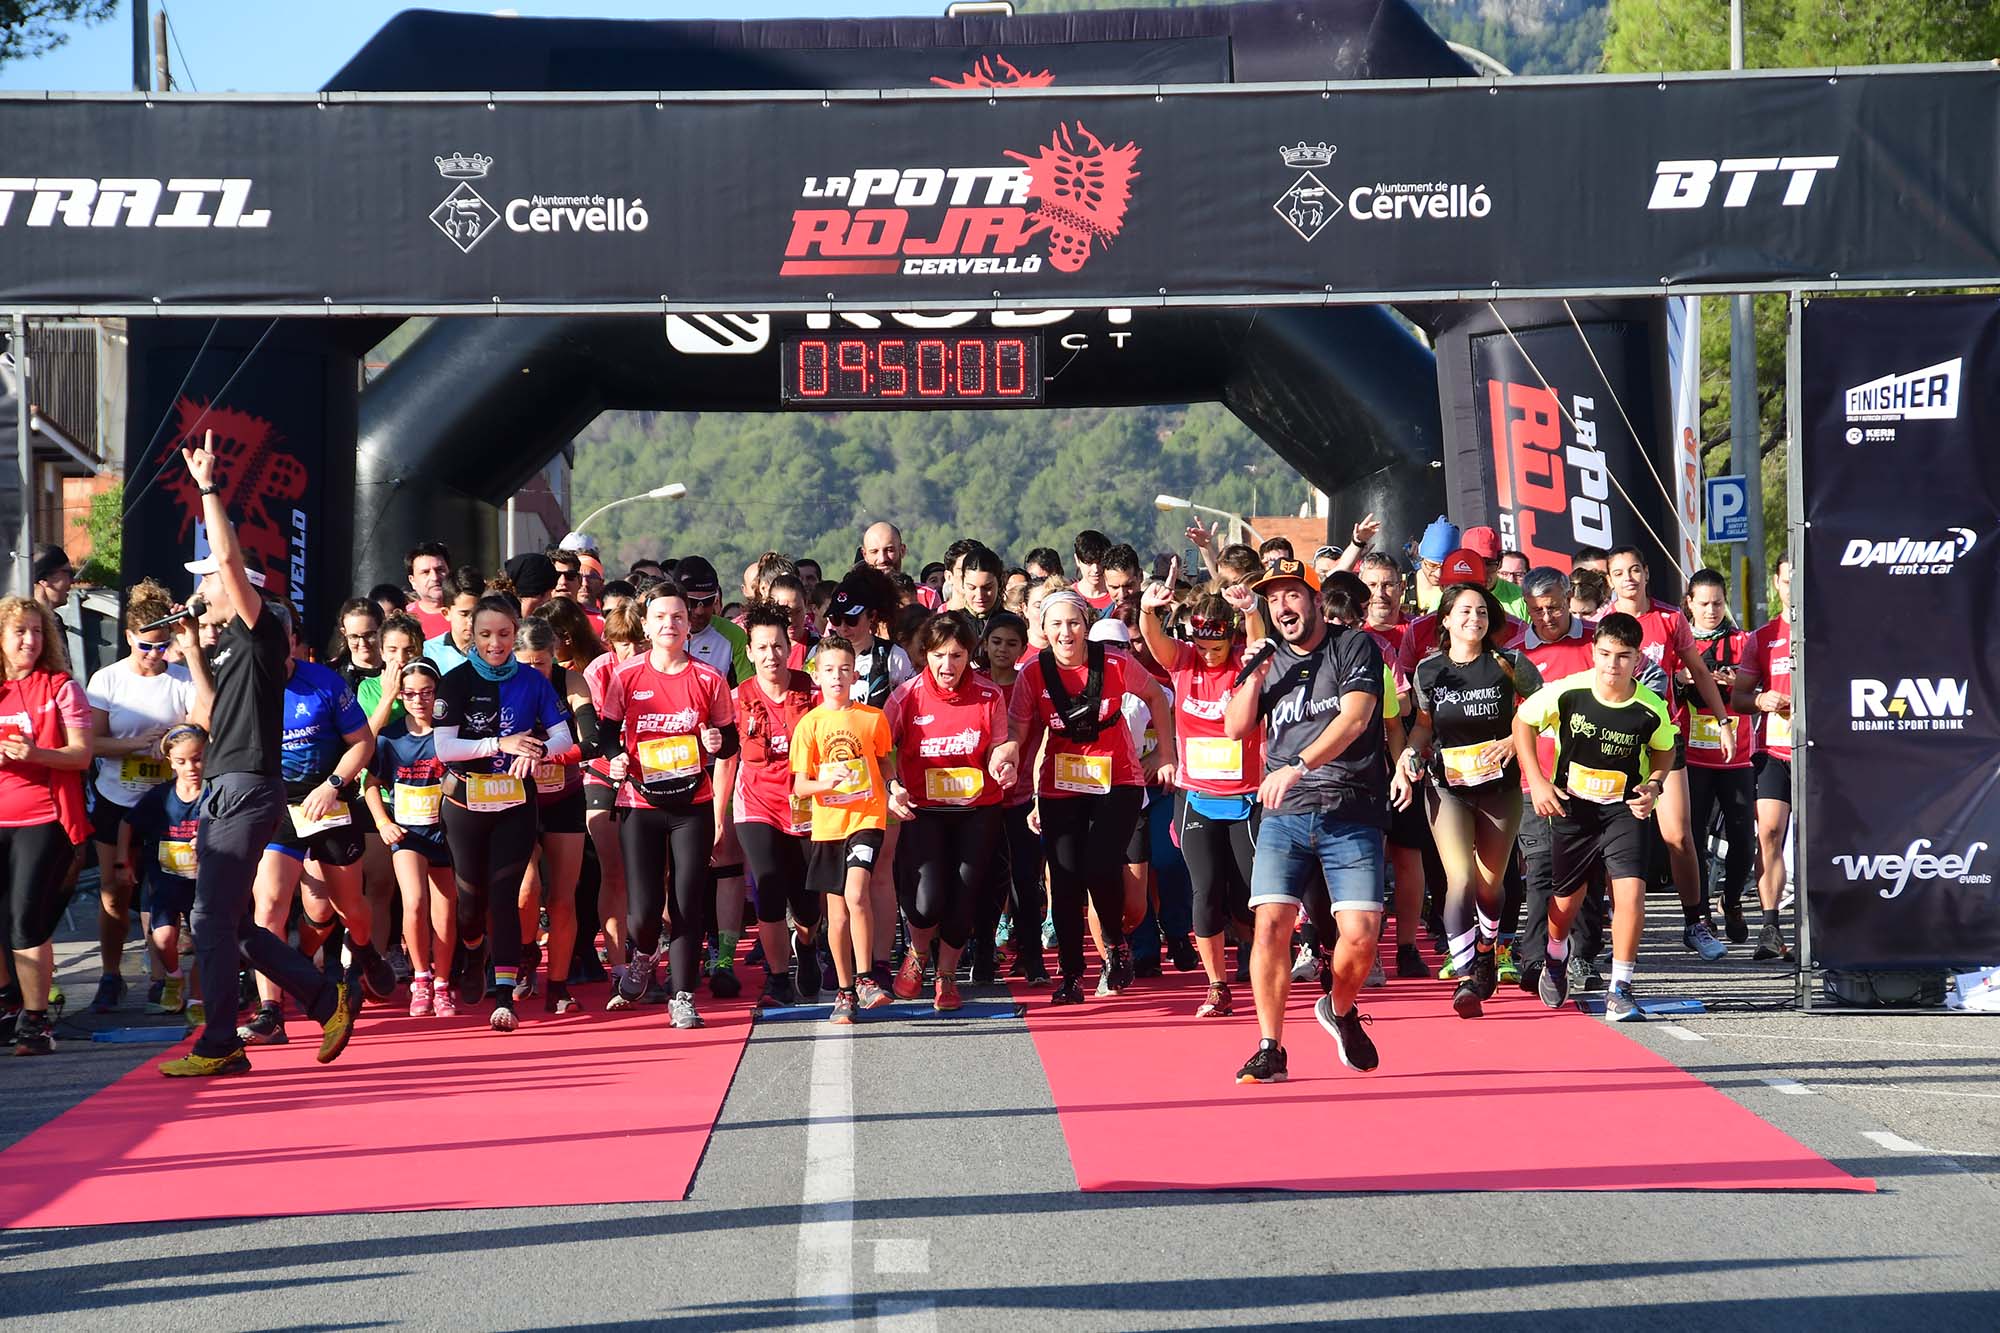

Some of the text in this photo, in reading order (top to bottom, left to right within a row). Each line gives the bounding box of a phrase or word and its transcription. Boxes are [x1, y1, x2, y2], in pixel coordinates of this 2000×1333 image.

[531, 194, 605, 207] Ajuntament de
[802, 167, 1034, 206] LA POTA
[1374, 181, 1448, 195] Ajuntament de
[1647, 155, 1840, 210] BTT
[0, 177, 272, 227] TRAIL
[505, 197, 649, 232] Cervelló
[1348, 184, 1492, 220] Cervelló
[785, 207, 1028, 256] ROJA
[903, 254, 1042, 275] CERVELLÓ
[799, 340, 1025, 396] 09:50:00
[1851, 373, 1949, 411] FINISHER
[1507, 382, 1573, 578] ROJ
[1566, 445, 1613, 550] PO
[1713, 483, 1744, 533] P
[1840, 537, 1955, 567] DAVIMA
[1889, 562, 1953, 575] rent a car
[1463, 702, 1500, 716] VALENTS
[1852, 719, 1964, 731] ORGANIC SPORT DRINK
[1832, 839, 1988, 899] wefeel
[1959, 873, 1991, 884] events
